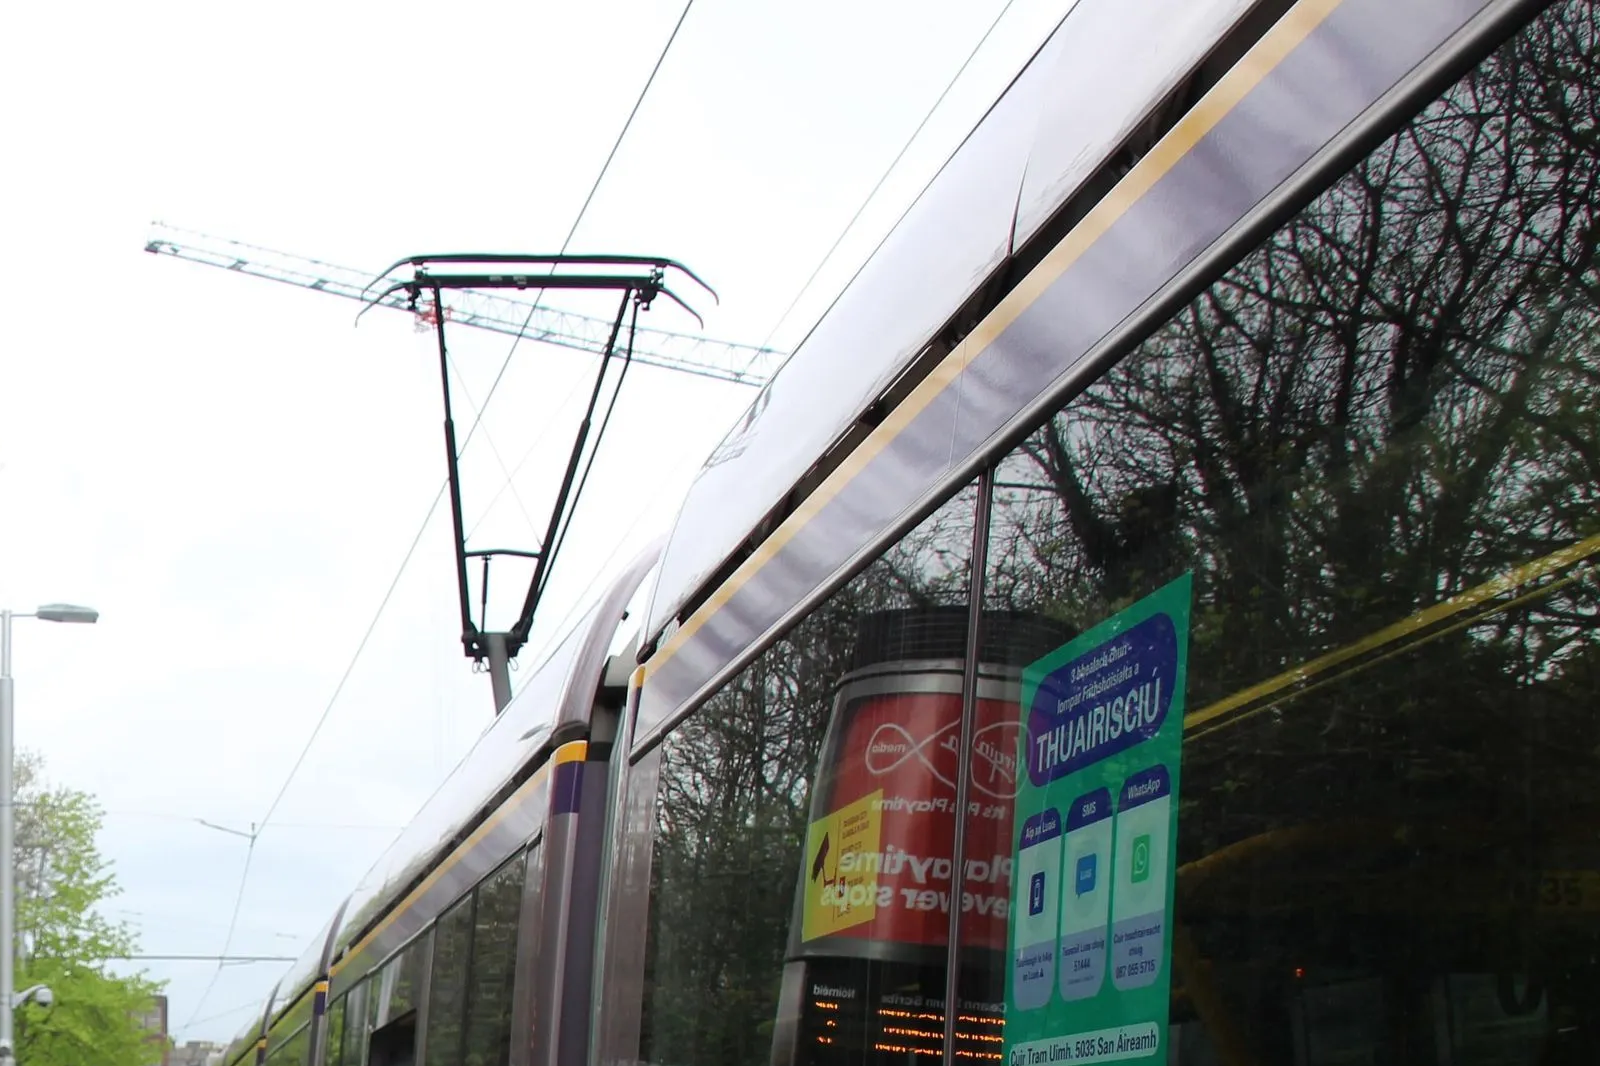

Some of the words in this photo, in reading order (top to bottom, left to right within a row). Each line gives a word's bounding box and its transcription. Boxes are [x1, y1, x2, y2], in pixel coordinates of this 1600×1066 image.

[1133, 662, 1140, 677] a
[1036, 666, 1161, 773] THUAIRISCIÚ
[1128, 779, 1160, 799] WhatsApp
[1082, 801, 1097, 818] SMS
[1028, 1048, 1047, 1065] Tram
[1050, 1042, 1073, 1062] Uimh.
[1075, 1038, 1095, 1058] 5035
[1098, 1036, 1114, 1055] San
[1117, 1028, 1157, 1053] Áireamh
